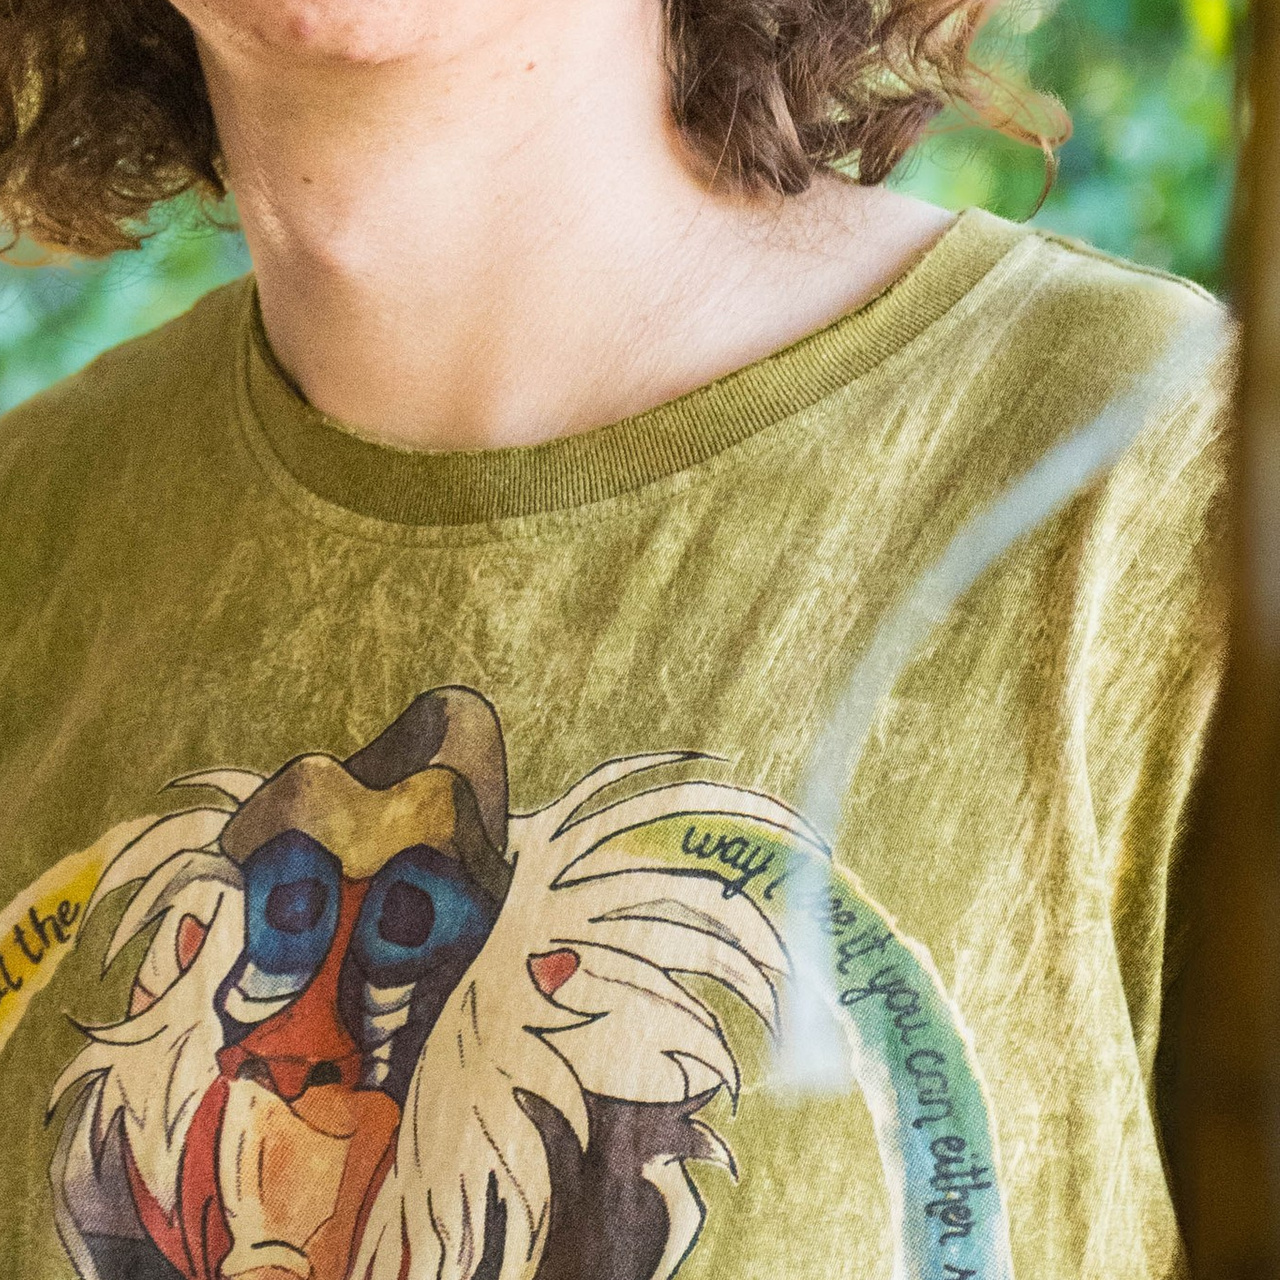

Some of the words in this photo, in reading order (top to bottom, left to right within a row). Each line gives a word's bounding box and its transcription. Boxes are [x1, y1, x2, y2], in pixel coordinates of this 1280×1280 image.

[681, 825, 776, 900] way
[13, 899, 81, 964] the
[836, 924, 895, 975] it
[839, 965, 928, 1046] you
[906, 1048, 954, 1129] can
[924, 1135, 992, 1247] either
